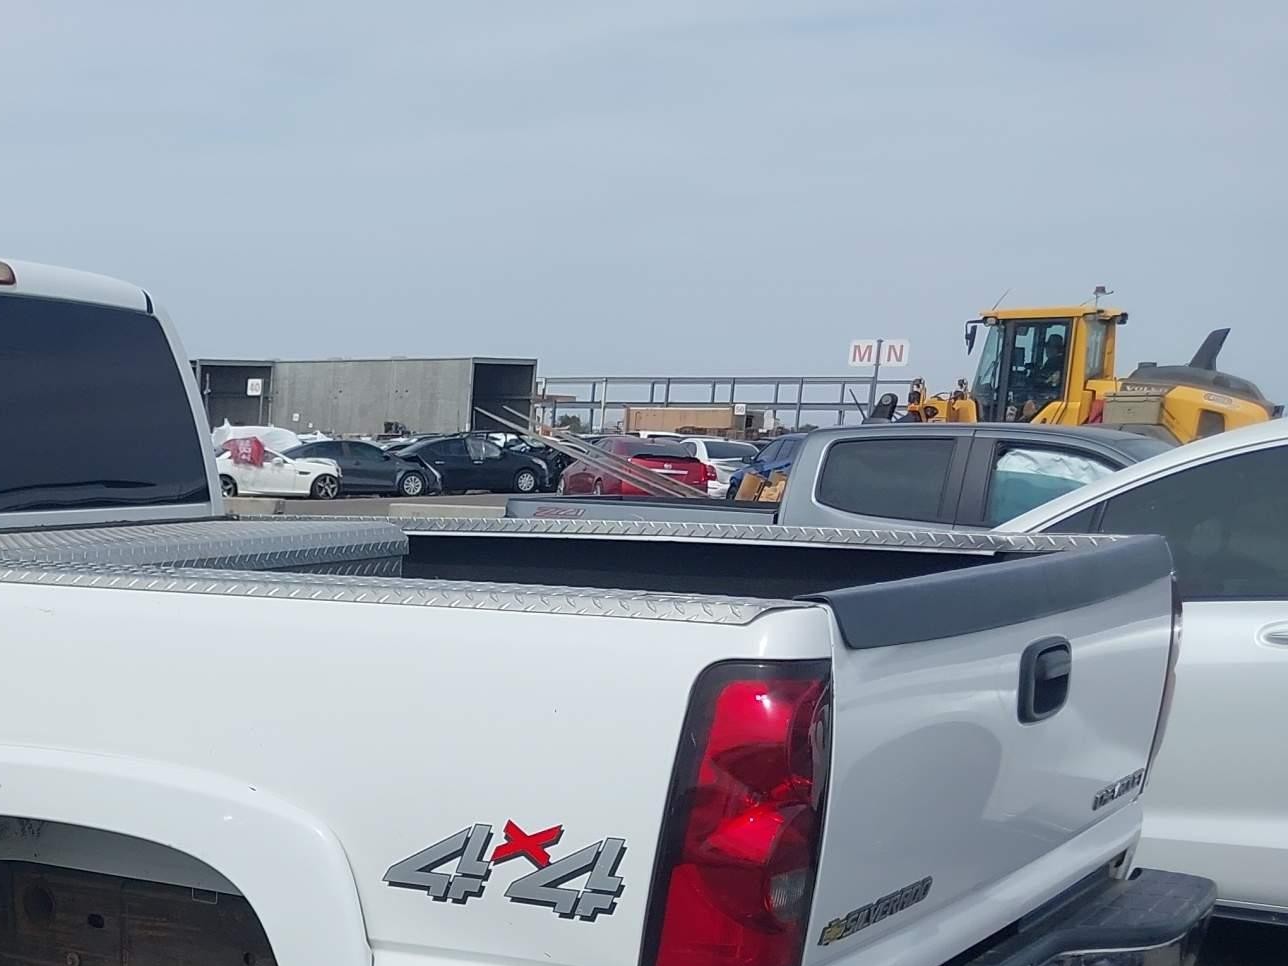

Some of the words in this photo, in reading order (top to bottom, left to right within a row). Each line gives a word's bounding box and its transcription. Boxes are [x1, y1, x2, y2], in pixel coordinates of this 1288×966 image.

[852, 344, 873, 362] M
[886, 344, 904, 362] N
[842, 875, 934, 938] SILVERADO
